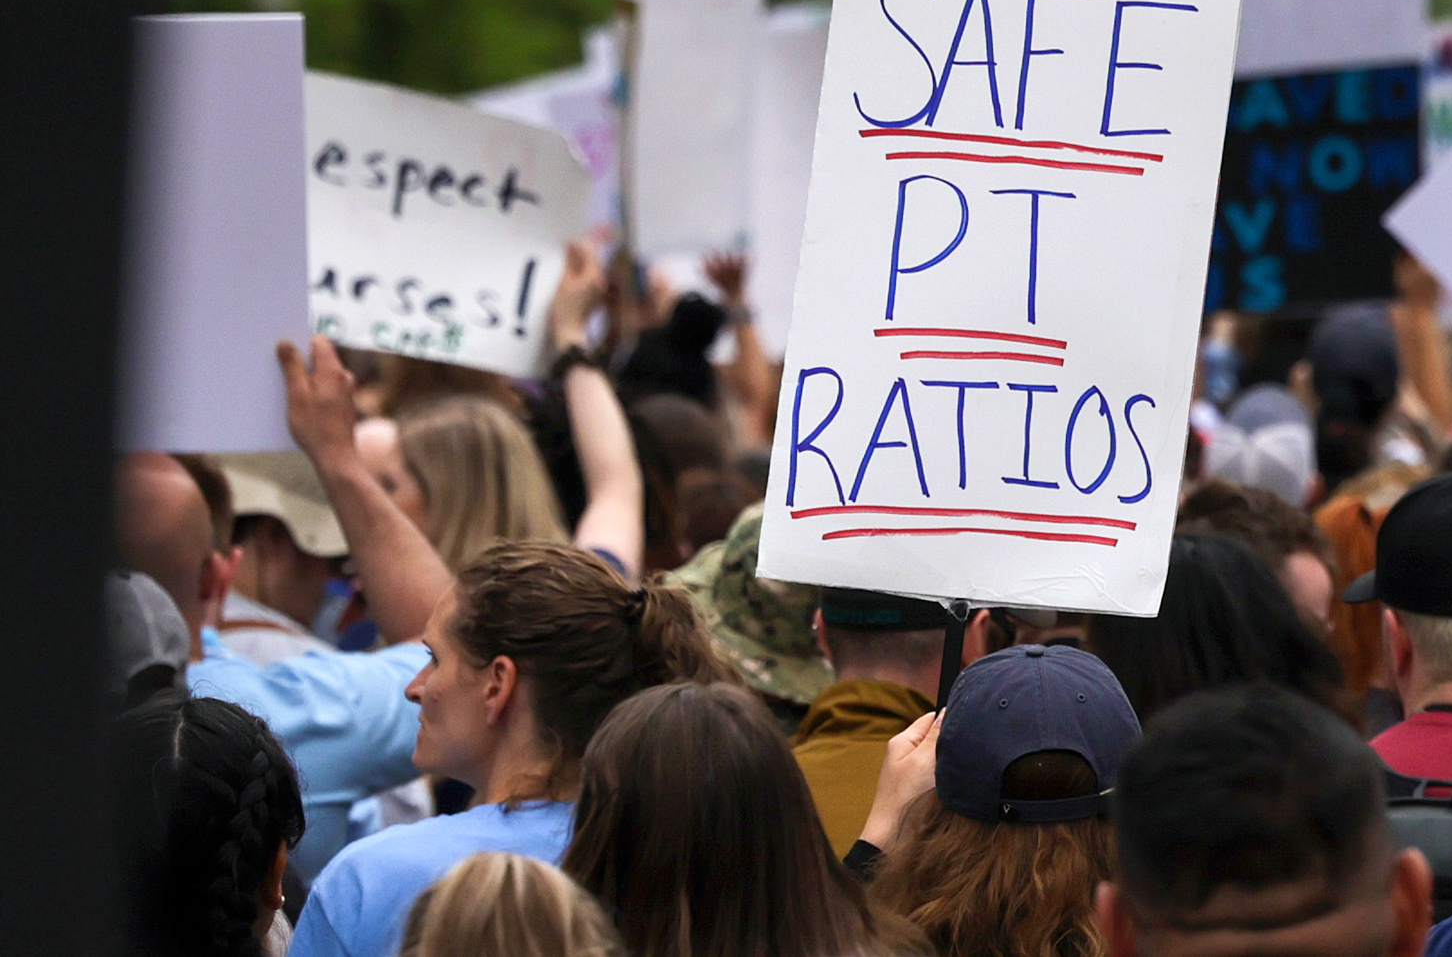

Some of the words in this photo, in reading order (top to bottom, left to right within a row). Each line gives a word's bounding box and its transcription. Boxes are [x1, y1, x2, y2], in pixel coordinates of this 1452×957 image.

[1230, 67, 1420, 132] AVED
[313, 142, 538, 214] espect
[885, 174, 1077, 325] PT
[1214, 196, 1324, 253] VE
[309, 259, 537, 337] urses!
[786, 367, 1156, 506] RATIOS
